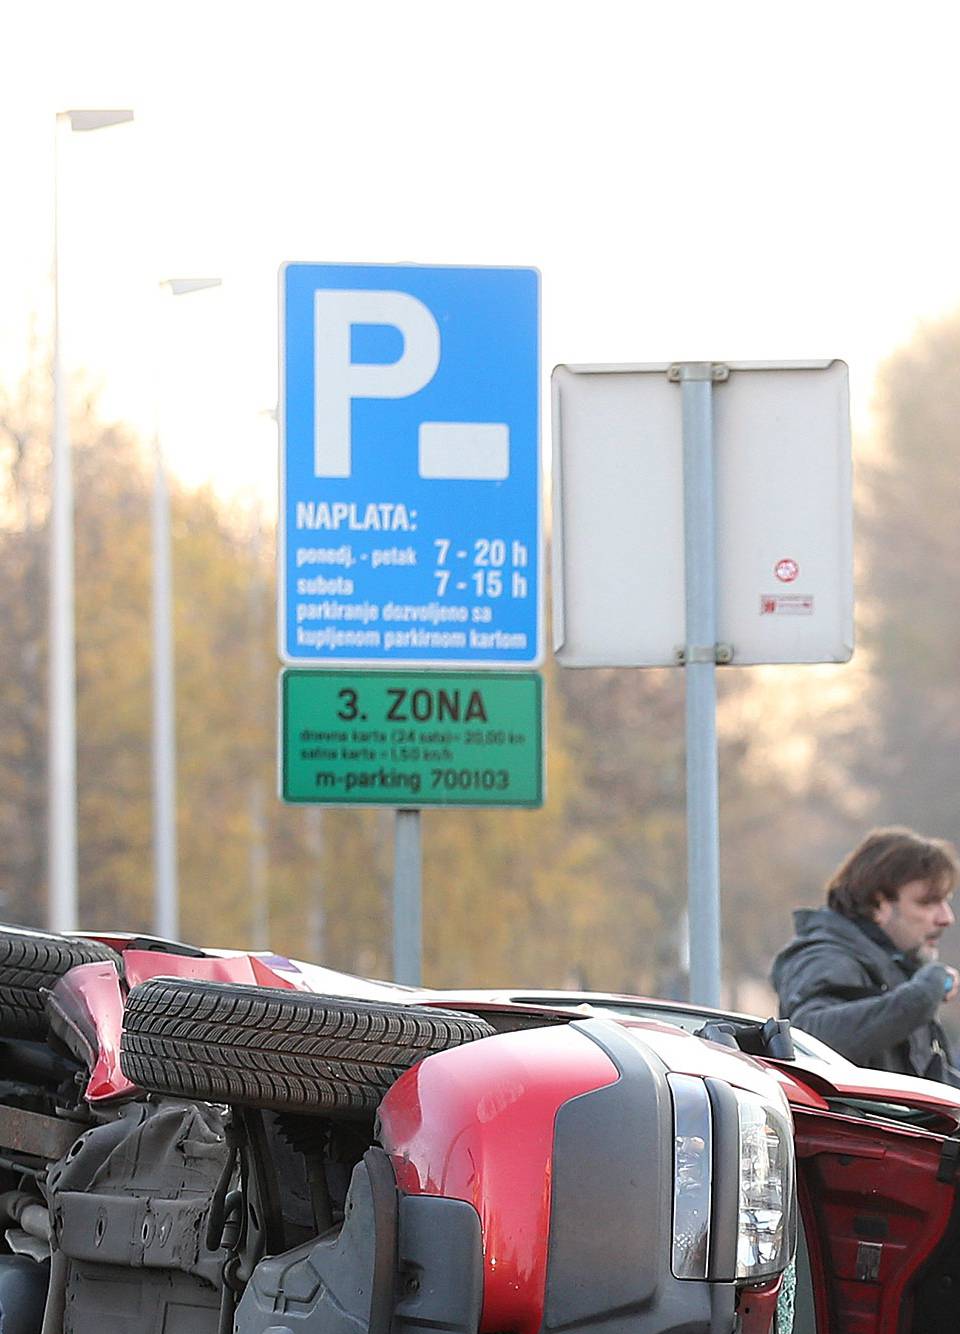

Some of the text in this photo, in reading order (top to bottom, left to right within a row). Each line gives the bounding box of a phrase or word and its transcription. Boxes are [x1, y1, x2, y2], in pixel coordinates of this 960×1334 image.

[314, 289, 441, 478] P
[296, 502, 417, 531] NAPLATA:
[296, 545, 356, 568] ponedj.
[372, 547, 417, 568] petak
[434, 539, 450, 565] 7
[473, 539, 506, 567] 20
[511, 541, 528, 567] h
[297, 576, 354, 595] subota
[434, 571, 450, 597] 7
[472, 570, 503, 597] 15
[511, 571, 528, 598] h
[296, 601, 492, 625] parkiranje dozvoljeno sa
[296, 627, 527, 651] kupljenom parkirnom kartom
[337, 688, 487, 722] 3. ZONA
[316, 767, 510, 792] m-parking 700103
